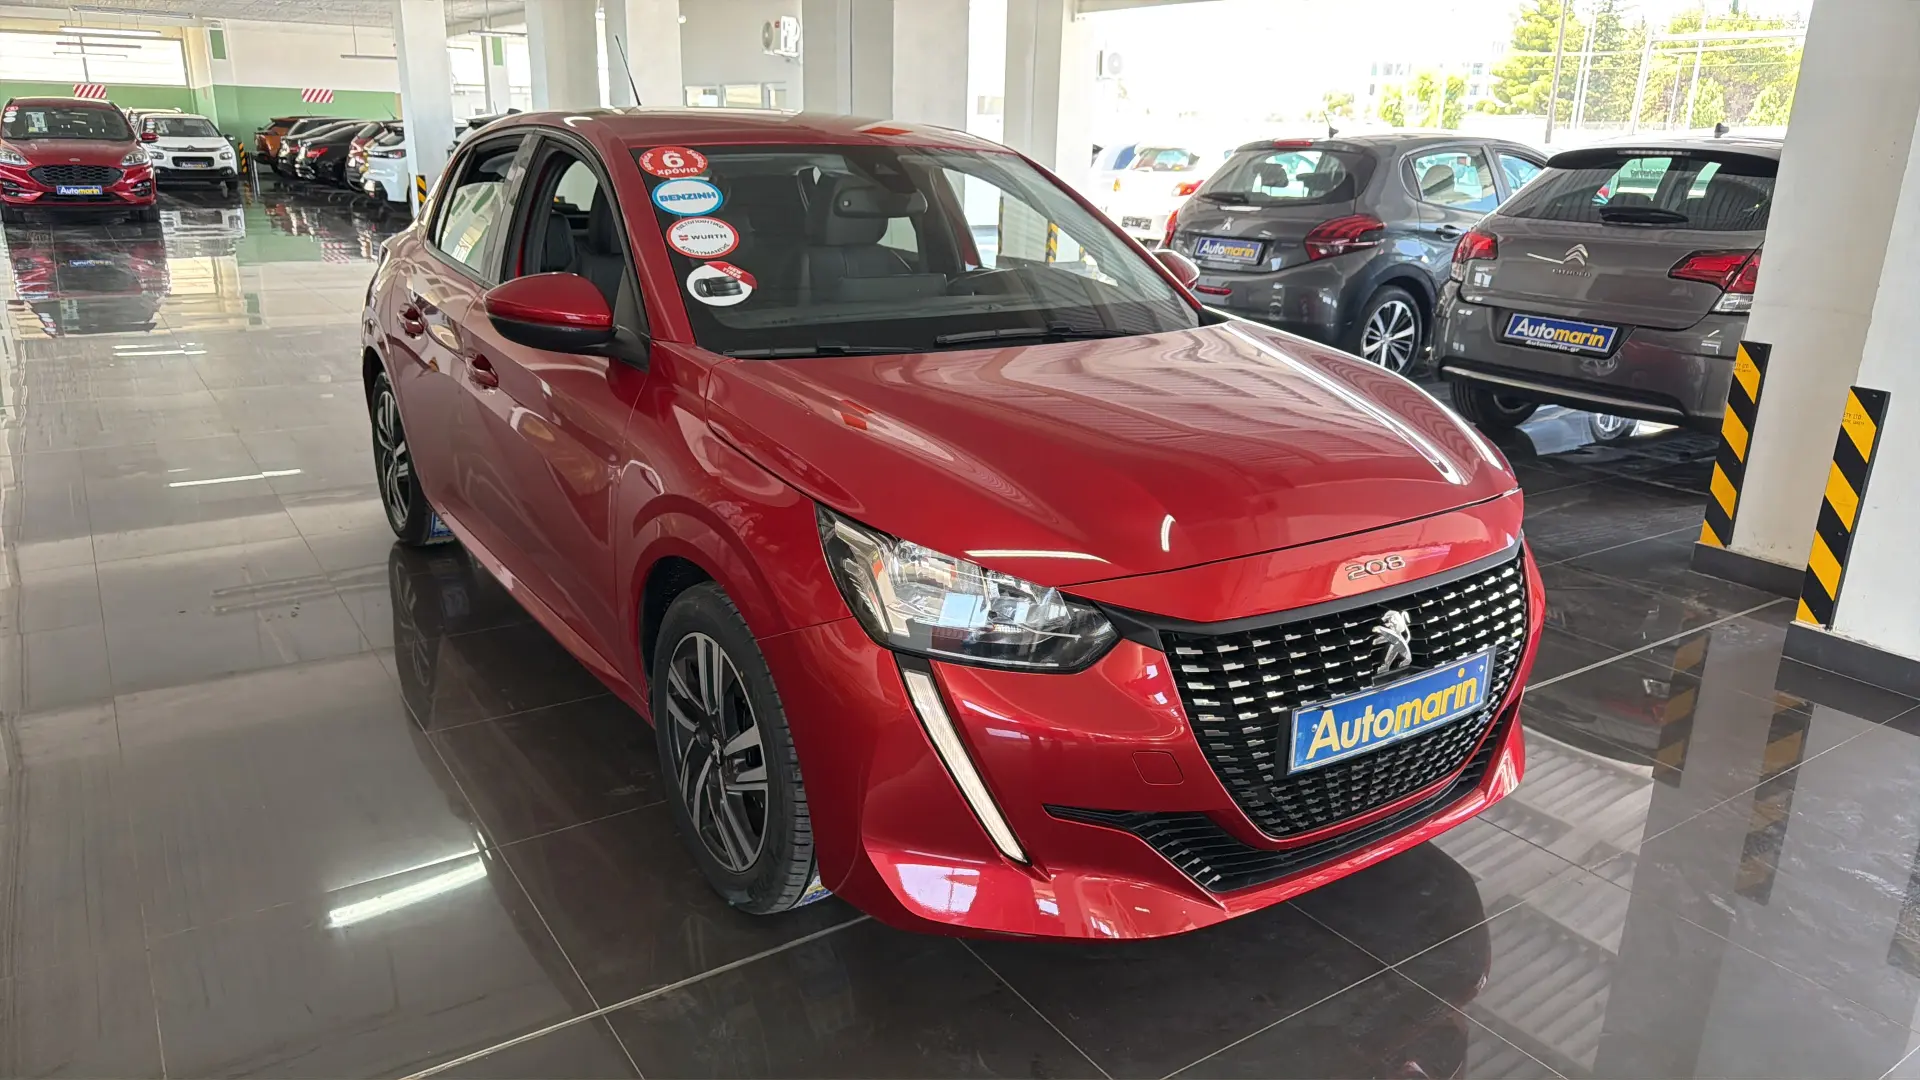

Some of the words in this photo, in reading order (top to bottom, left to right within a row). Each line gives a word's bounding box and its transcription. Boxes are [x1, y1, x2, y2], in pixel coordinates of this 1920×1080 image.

[662, 152, 685, 168] 6
[657, 167, 698, 175] χρόνια
[60, 186, 100, 195] Automarin
[659, 192, 716, 202] ΒΕΝΖΙΝΗ
[1199, 239, 1256, 258] Automarin
[1512, 317, 1605, 348] Automarin
[1525, 339, 1581, 353] Automarin.gr
[1345, 554, 1406, 581] 208
[1305, 667, 1478, 760] Automarin
